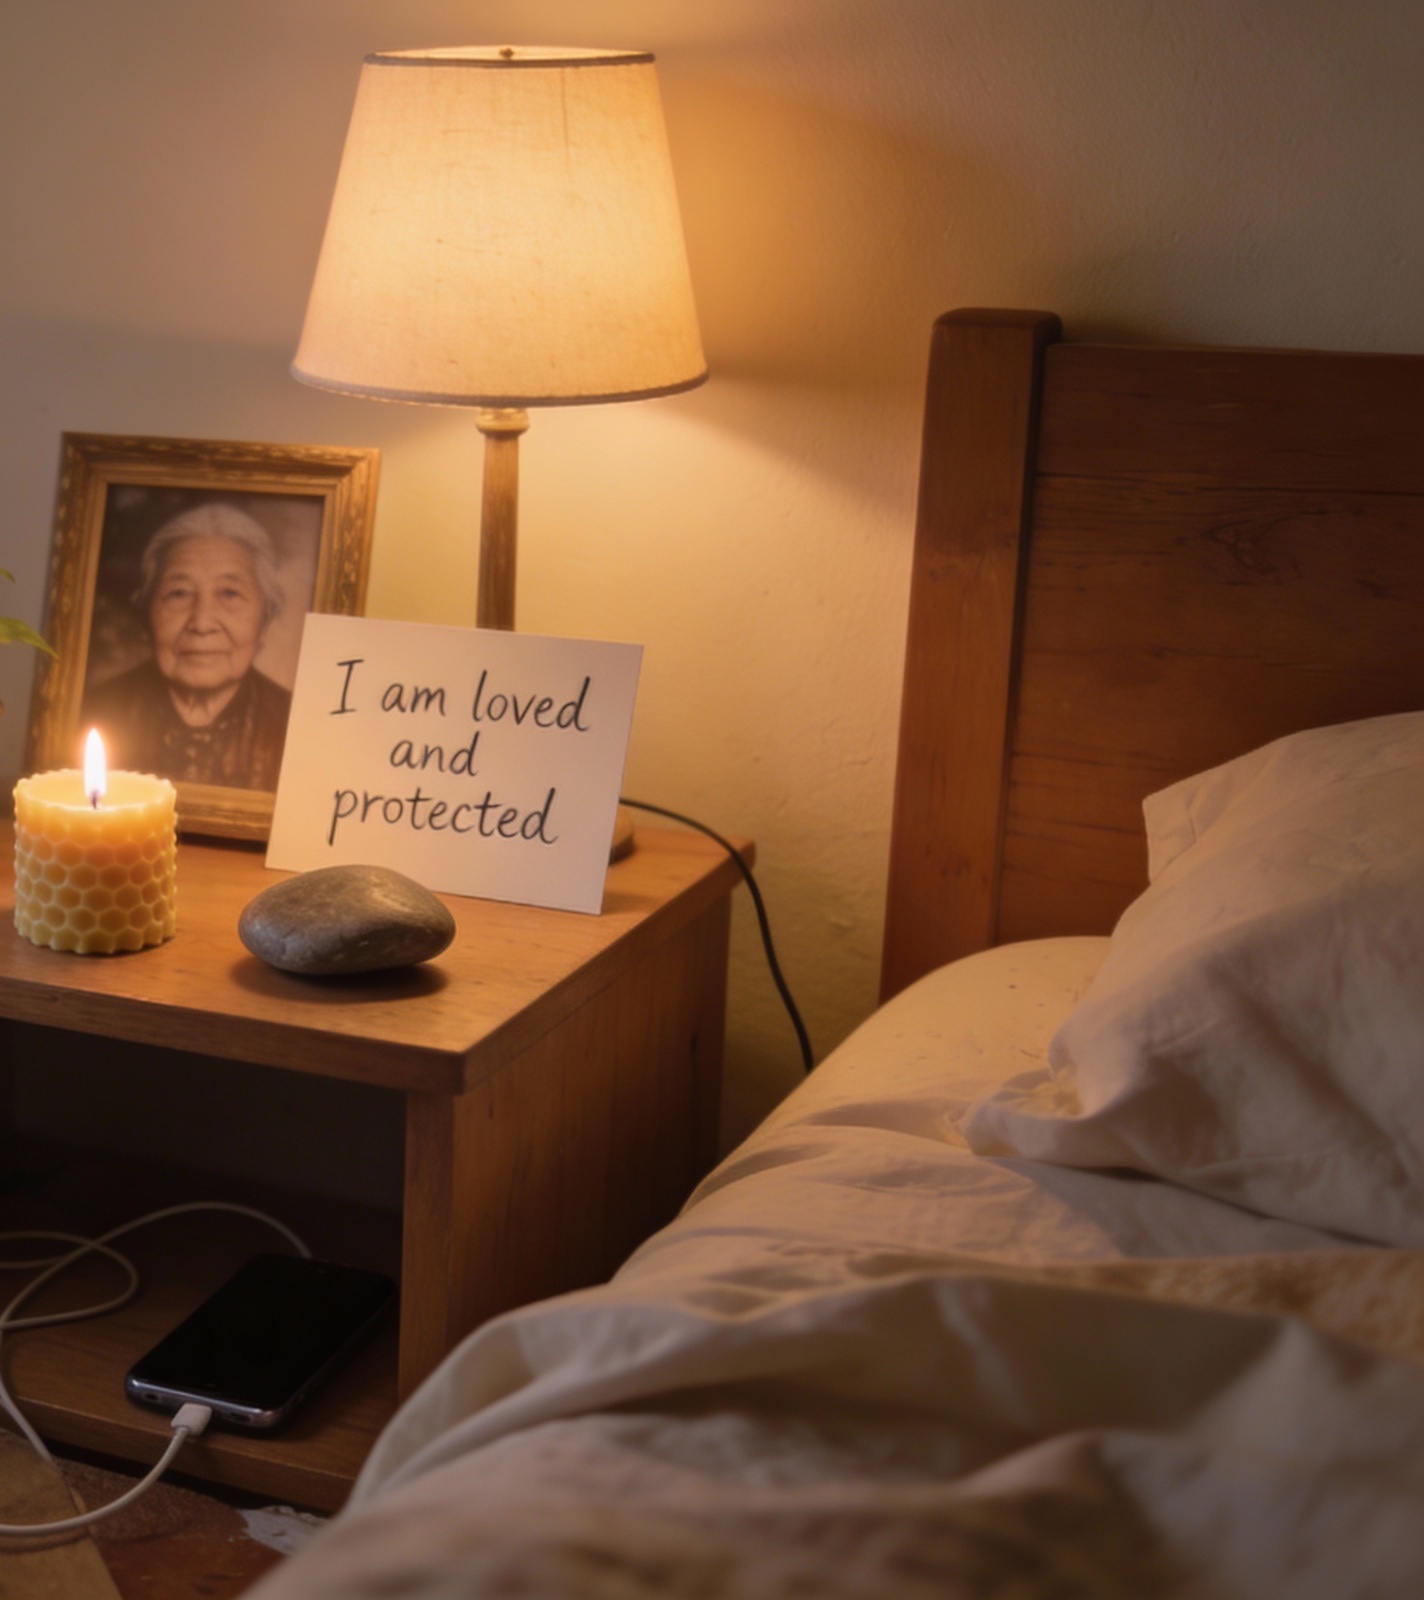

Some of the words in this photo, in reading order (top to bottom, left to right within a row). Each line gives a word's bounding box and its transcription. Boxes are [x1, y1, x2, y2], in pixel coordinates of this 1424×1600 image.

[330, 658, 364, 715] I
[381, 682, 446, 717] am
[472, 669, 591, 732] loved
[389, 731, 480, 777] and
[327, 787, 559, 847] protected
